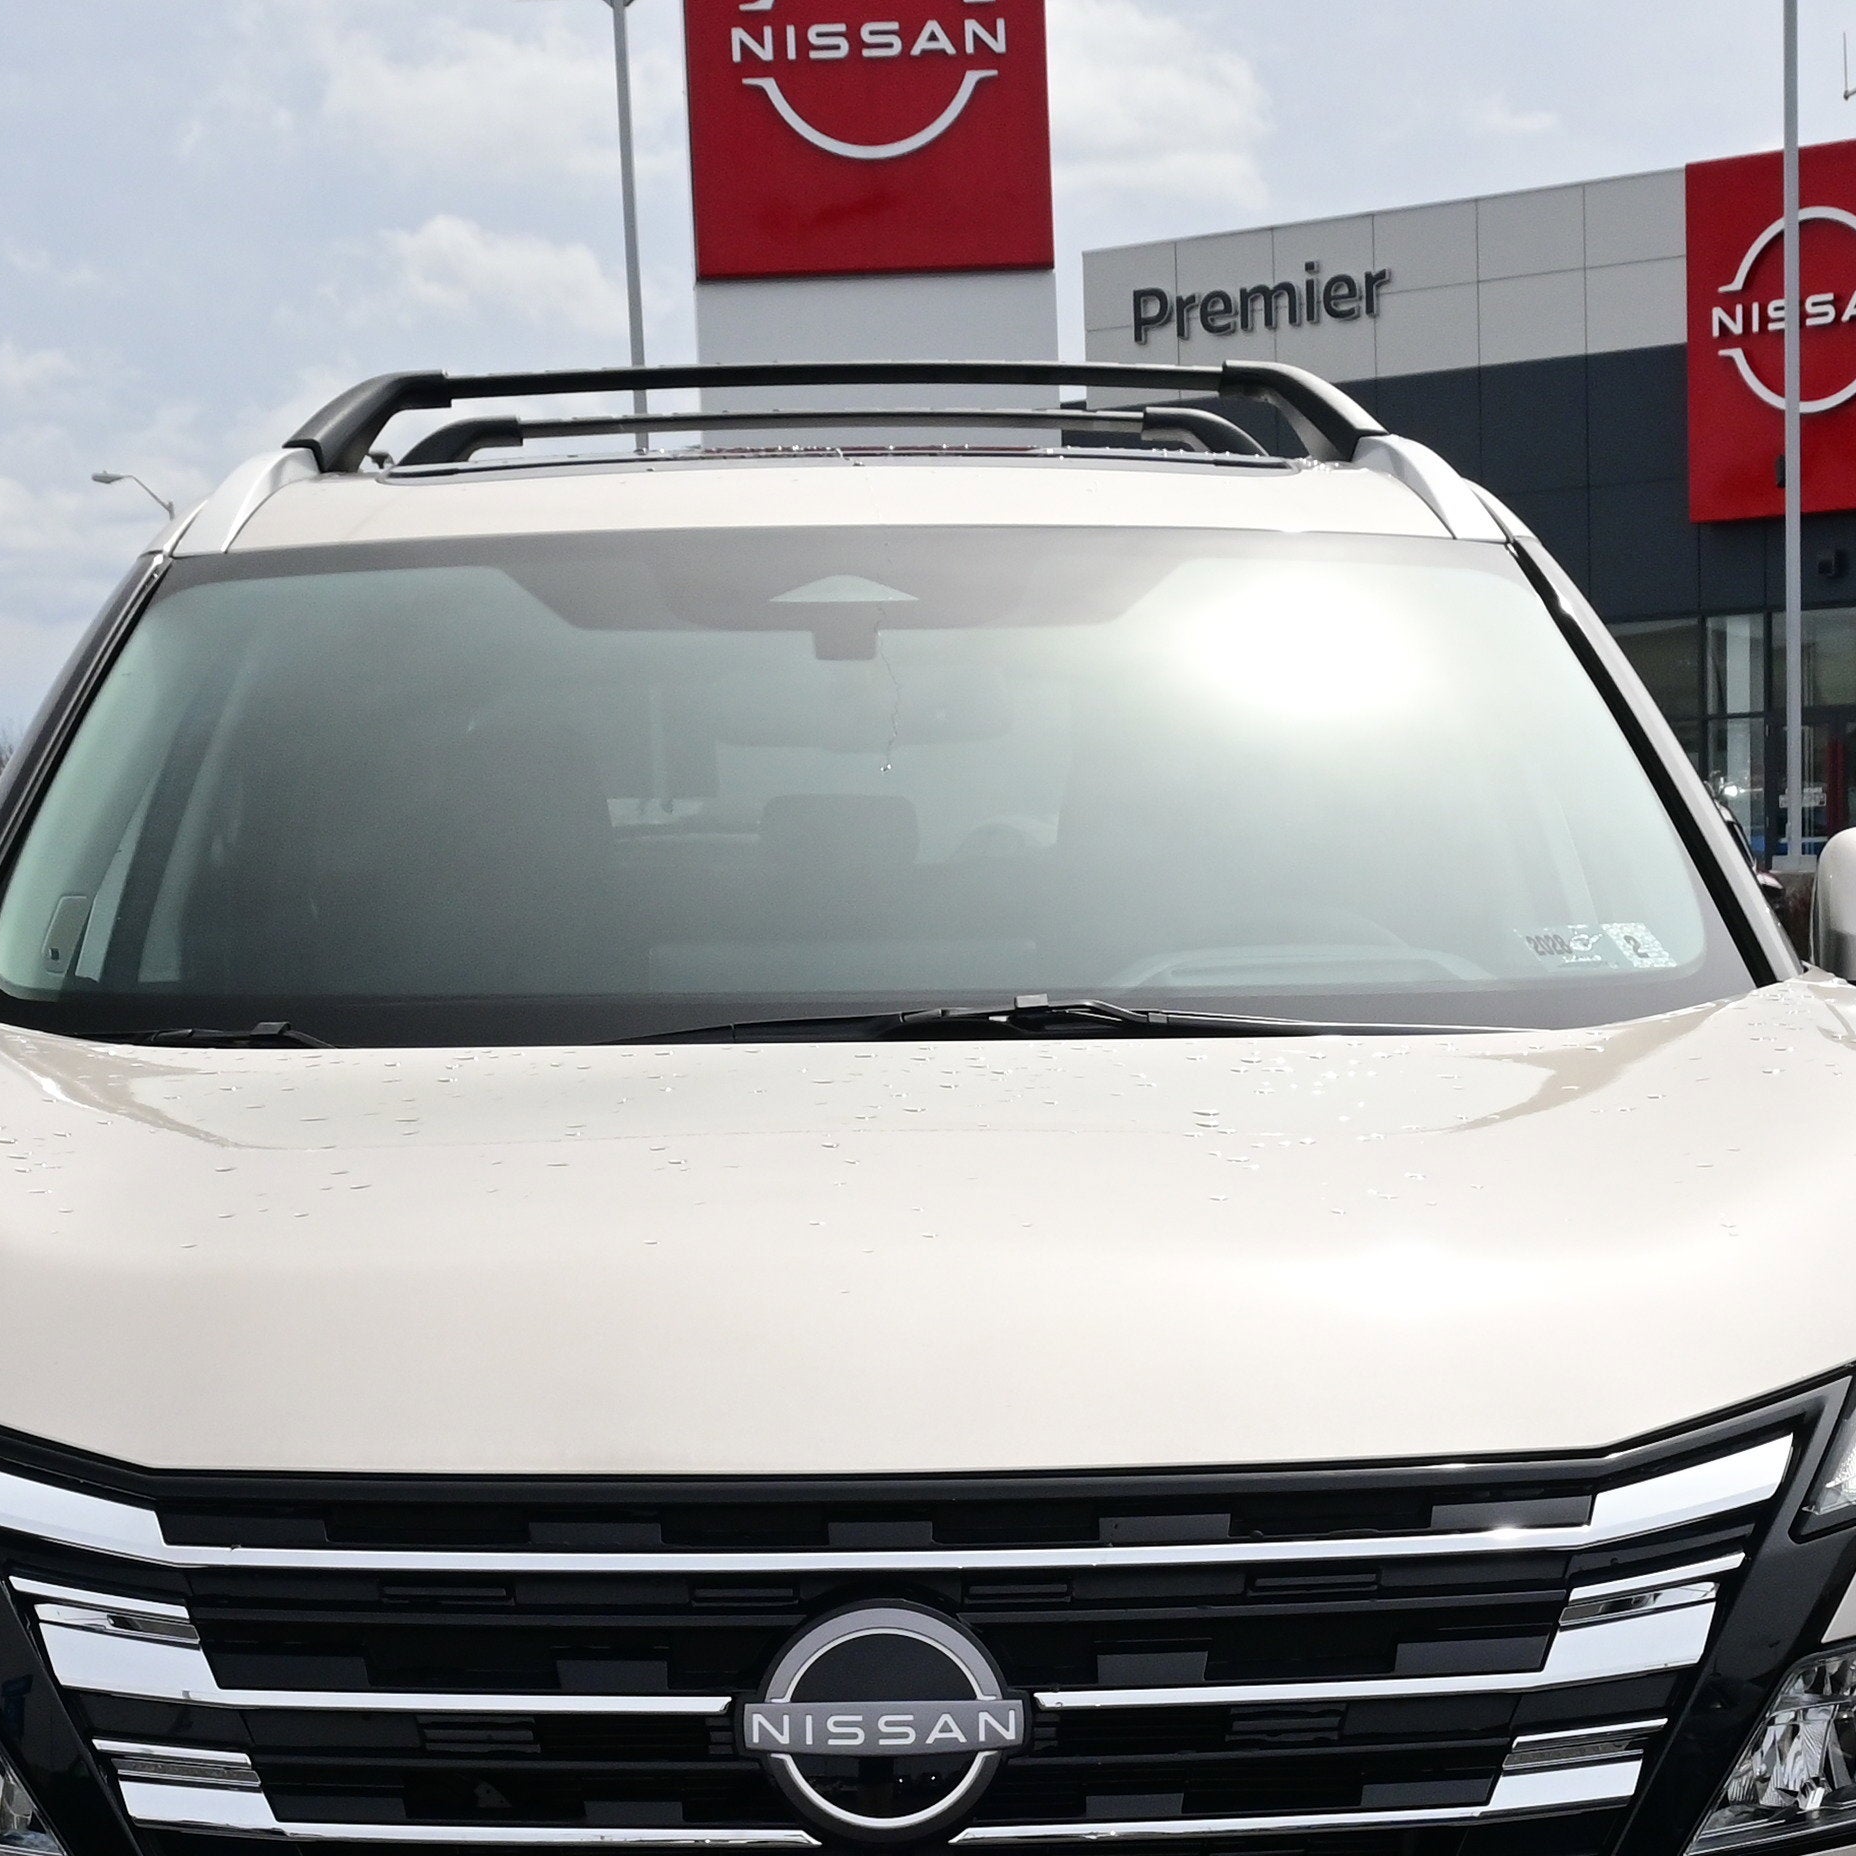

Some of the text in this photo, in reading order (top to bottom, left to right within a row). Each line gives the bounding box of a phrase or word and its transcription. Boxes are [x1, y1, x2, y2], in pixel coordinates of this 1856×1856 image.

[731, 17, 1006, 63] NISSAN
[1132, 261, 1392, 344] Premier
[752, 1710, 1016, 1746] NISSAN
